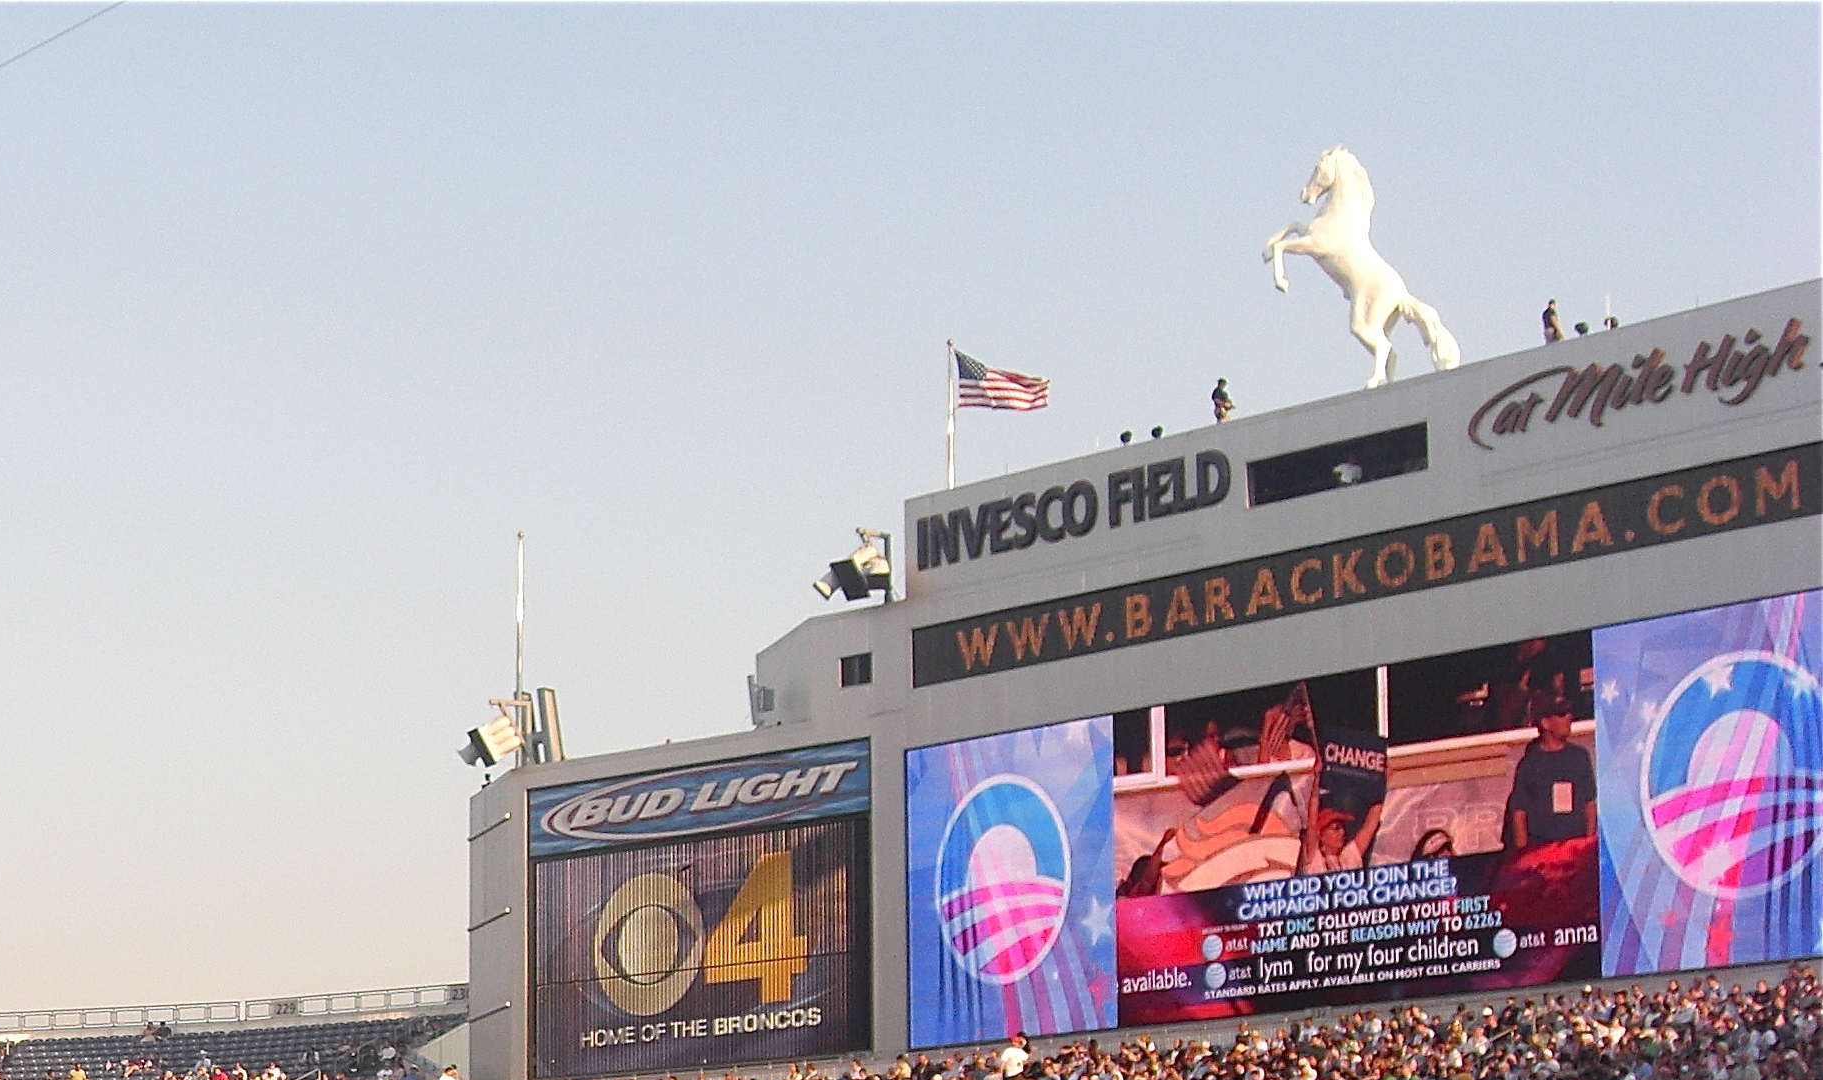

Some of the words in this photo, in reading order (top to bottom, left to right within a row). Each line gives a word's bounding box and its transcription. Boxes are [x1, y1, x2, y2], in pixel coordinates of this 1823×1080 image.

[1544, 347, 1675, 427] Mile
[1684, 317, 1810, 407] High
[916, 479, 1099, 571] INVESCO
[1108, 449, 1232, 529] FIELD
[956, 459, 1803, 671] WWW.BARACKOBAMA.COM
[1325, 741, 1385, 773] CHANGE
[569, 787, 686, 831] BUD
[690, 760, 858, 813] LIGHT
[1238, 893, 1329, 920] CAMPAIGN
[1333, 888, 1369, 908] FOR
[1373, 877, 1457, 905] CHANGE?
[1243, 883, 1285, 900] WHY
[1288, 876, 1321, 896] DID
[1324, 871, 1364, 892] YOU
[1367, 864, 1408, 891] JOIN
[1412, 859, 1449, 879] THE
[704, 851, 809, 1004] 4
[1250, 936, 1288, 955] NAME
[1290, 932, 1320, 951] AND
[1322, 929, 1349, 947] THE
[1351, 922, 1404, 943] REASON
[1407, 917, 1438, 937] WHY
[1441, 915, 1462, 933] TO
[1465, 909, 1502, 931] 62262
[1257, 920, 1284, 938] TXT
[1286, 916, 1315, 935] DNC
[1319, 907, 1389, 931] FOLLOWED
[1391, 904, 1409, 921] BY
[1411, 899, 1450, 920] YOUR
[1453, 894, 1490, 914] FIRST
[1122, 966, 1193, 994] available.
[1259, 955, 1294, 984] lynn
[1308, 949, 1333, 974] for
[1337, 950, 1364, 975] my
[1368, 942, 1404, 966] four
[1408, 935, 1479, 962] children
[1554, 923, 1598, 947] anna
[1204, 984, 1257, 1000] STANDARD
[1377, 969, 1394, 982] ON
[1396, 965, 1425, 980] MOST
[1426, 962, 1450, 977] CELL
[581, 1025, 637, 1049] HOME
[641, 1022, 667, 1043] OF
[670, 1018, 708, 1039] THE
[712, 1006, 822, 1037] BRONCOS
